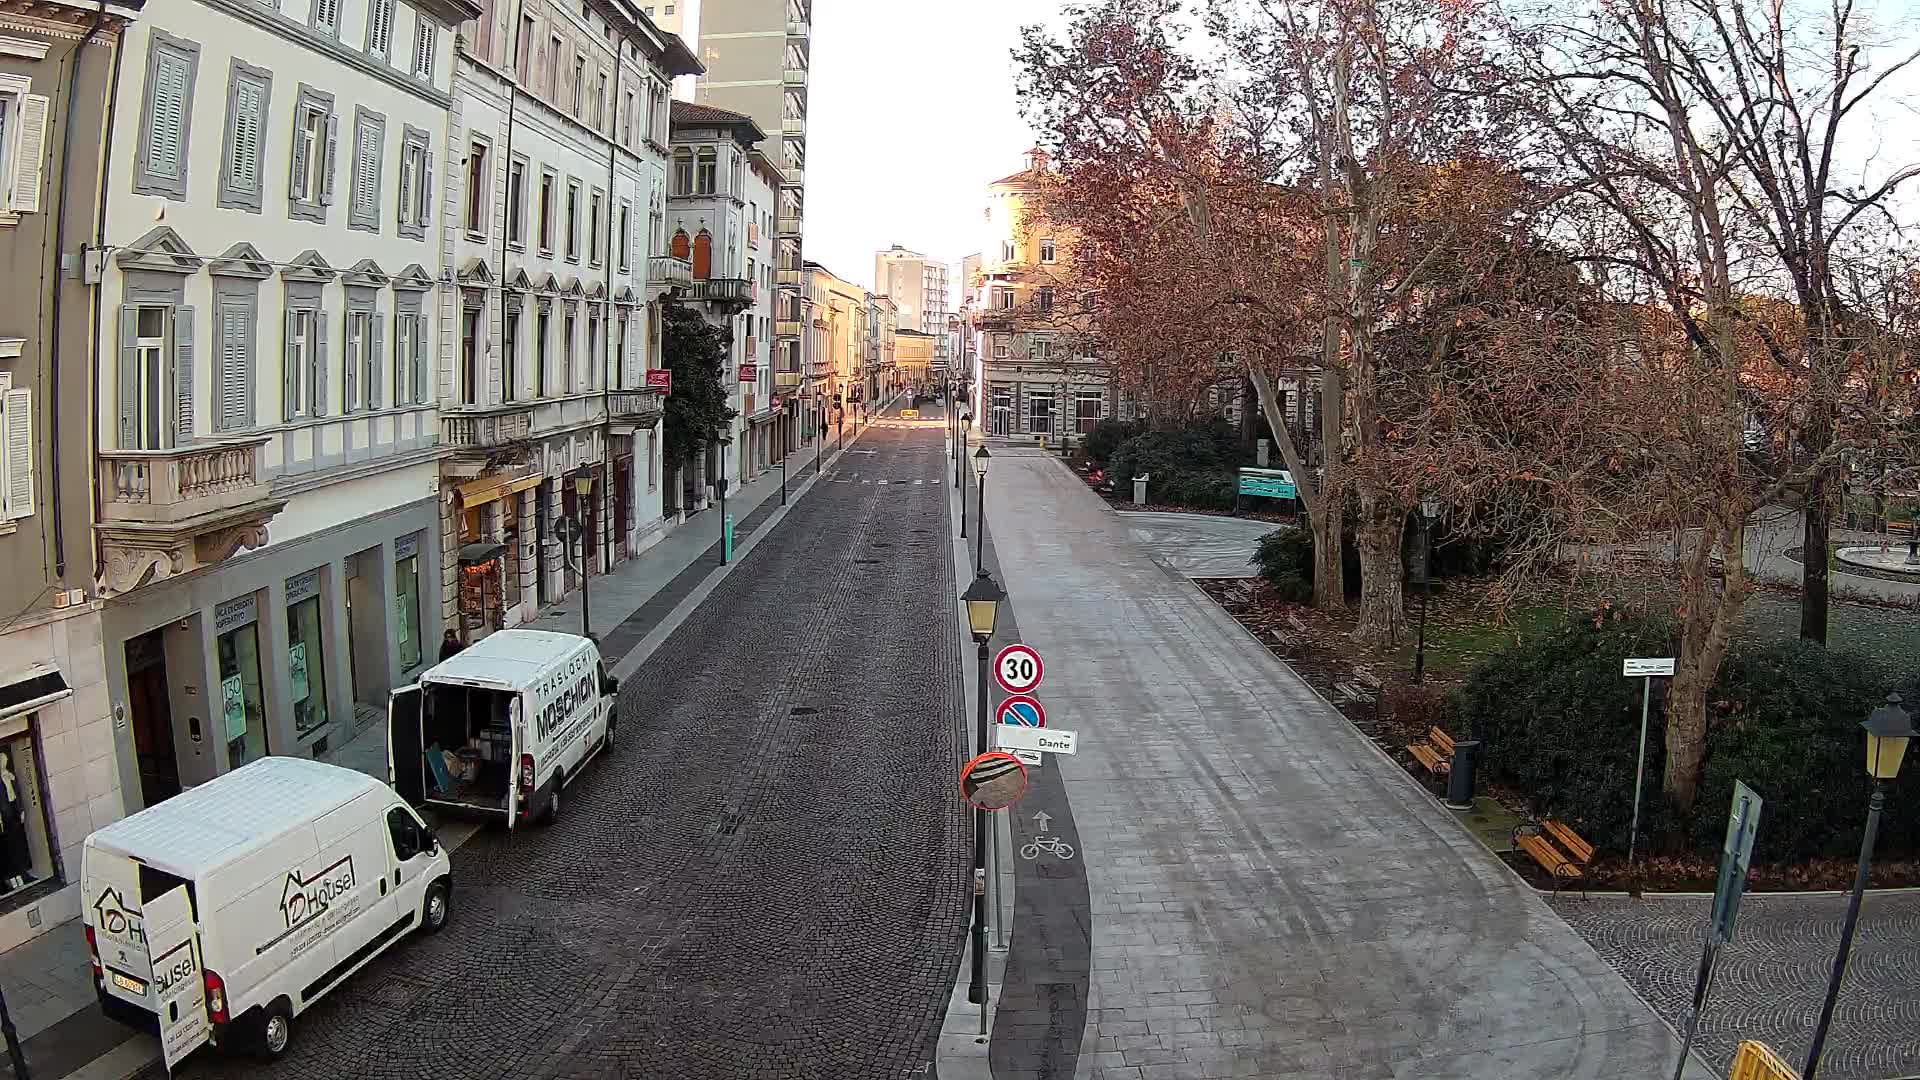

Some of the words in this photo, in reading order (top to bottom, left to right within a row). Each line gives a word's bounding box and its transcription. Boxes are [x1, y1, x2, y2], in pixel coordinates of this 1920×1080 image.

[536, 650, 591, 700] TRASLOCHI
[1006, 658, 1033, 680] 30
[536, 671, 595, 743] MOSCHION
[1038, 738, 1070, 748] Dante
